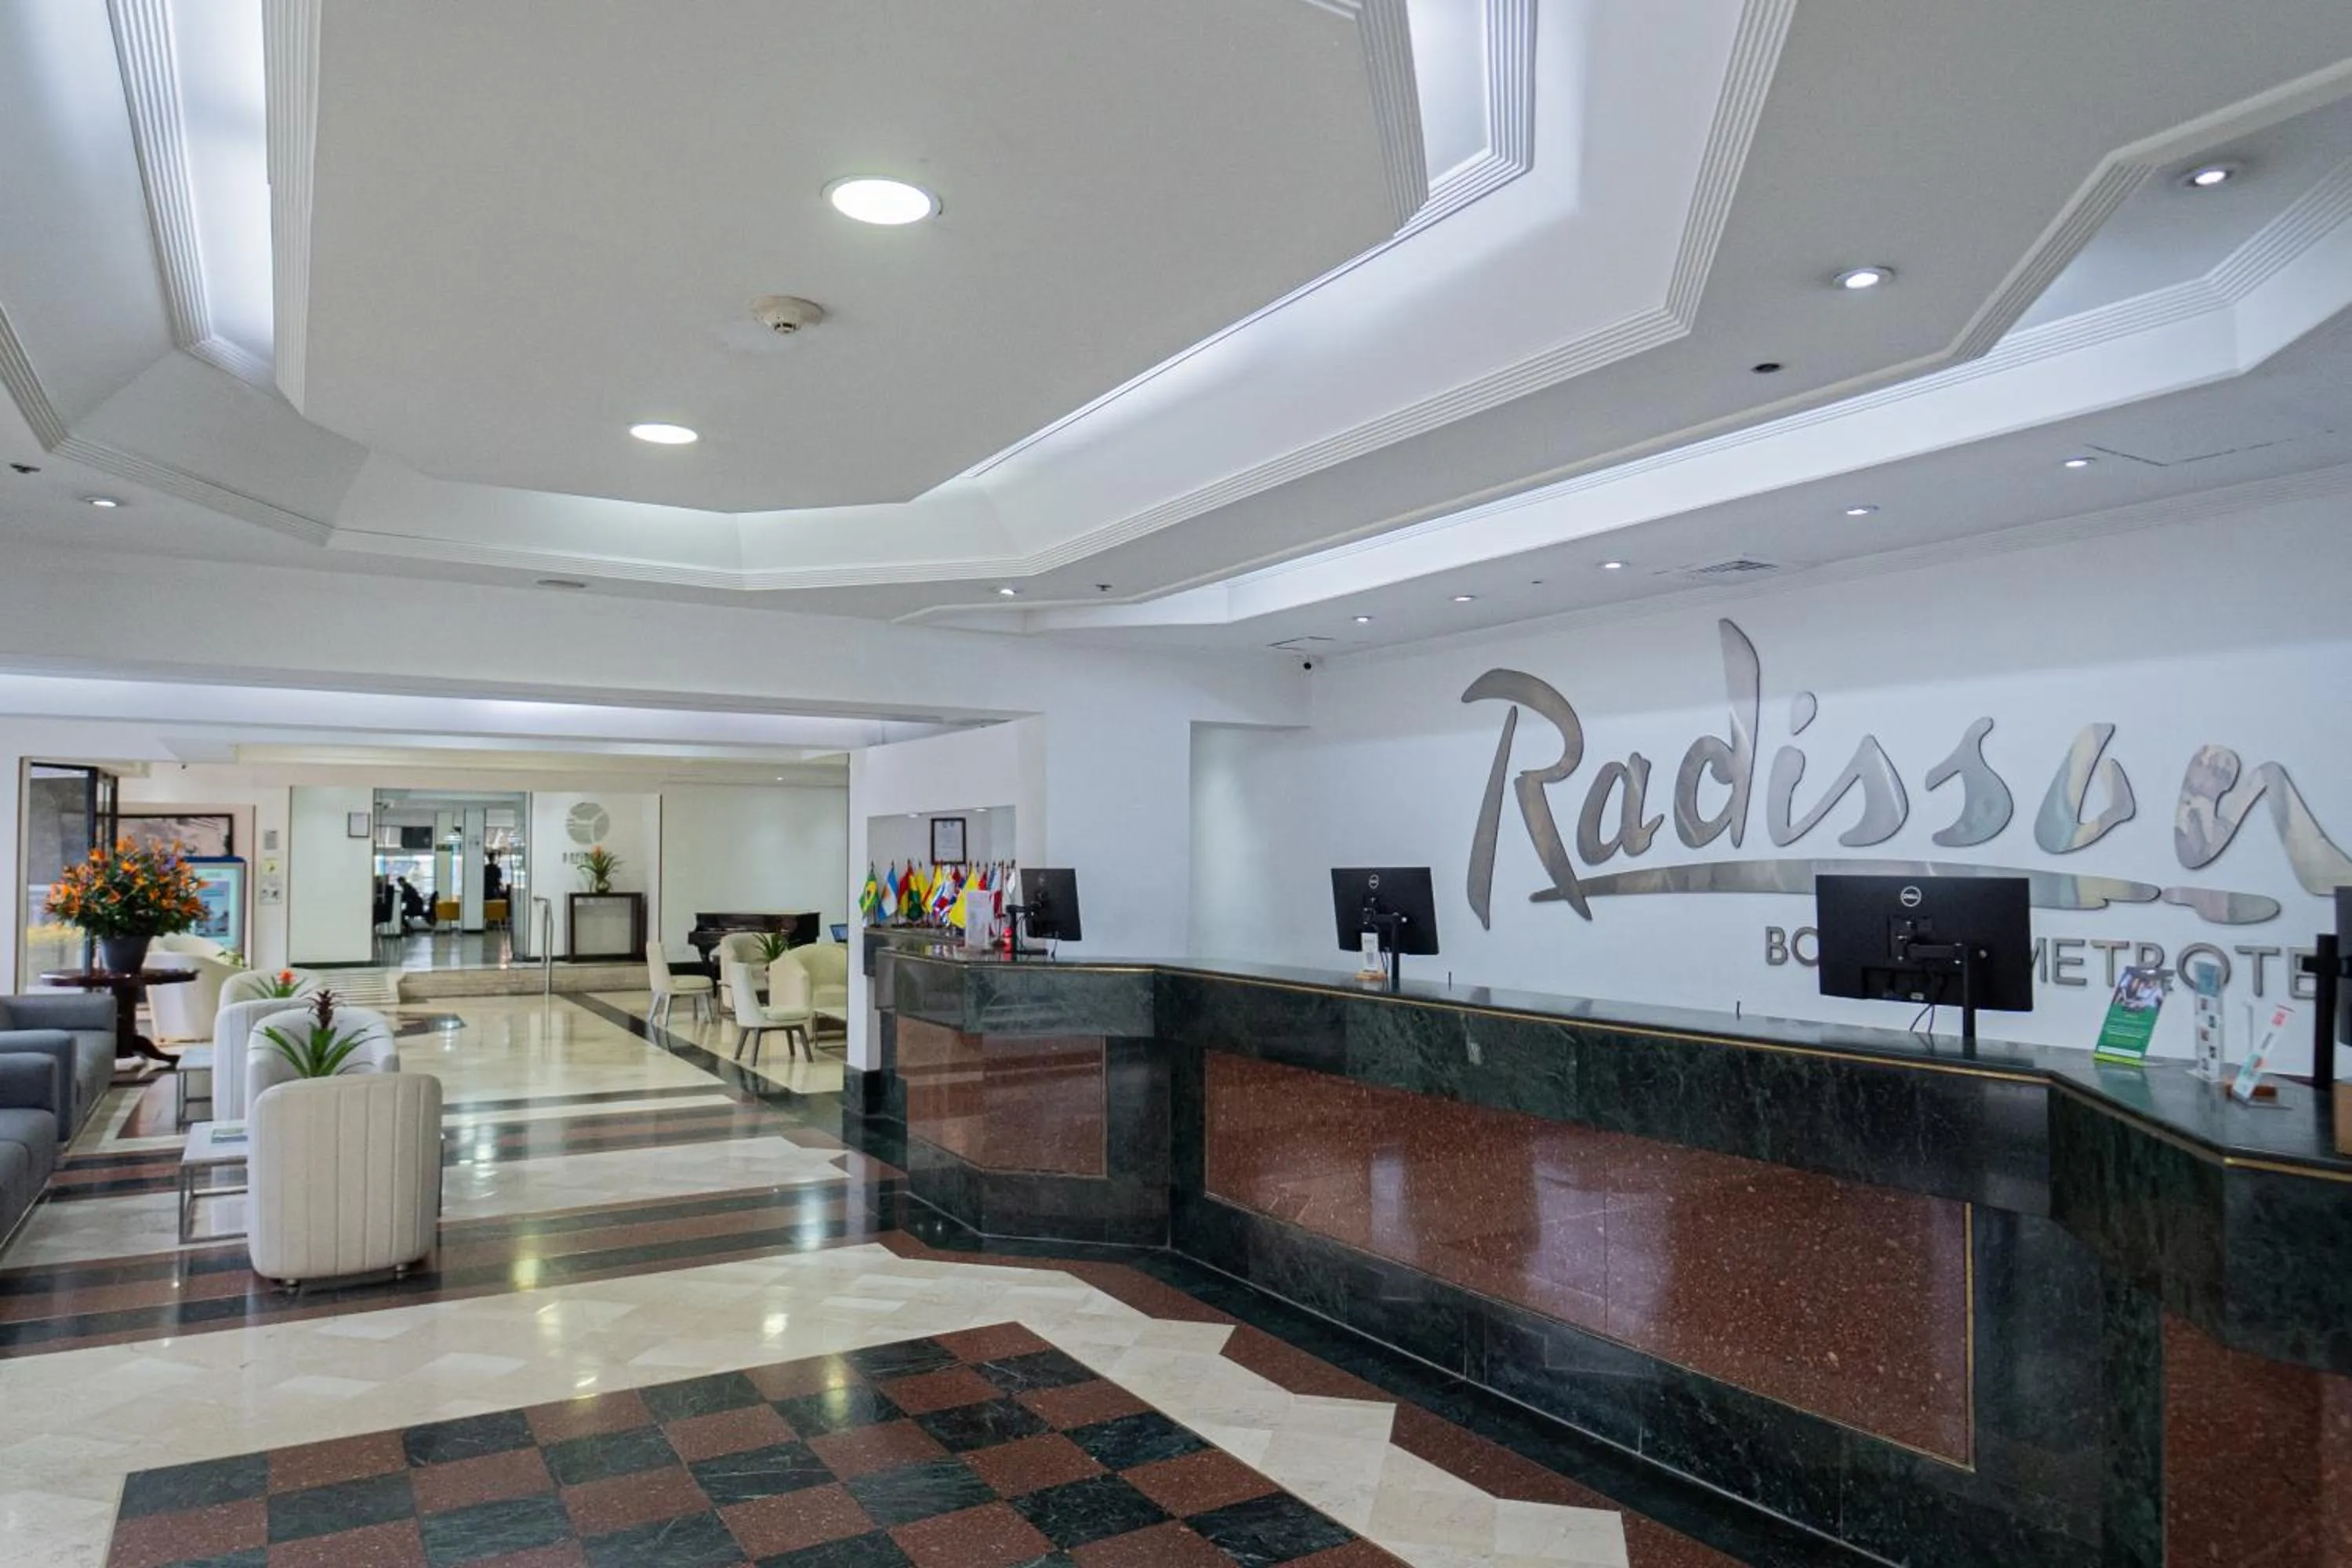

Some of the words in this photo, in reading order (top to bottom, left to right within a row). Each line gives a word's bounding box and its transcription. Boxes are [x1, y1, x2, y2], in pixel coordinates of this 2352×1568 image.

[1461, 616, 2352, 930] Radisson
[1766, 926, 1819, 967] BO
[2031, 937, 2318, 1000] ETROTE
